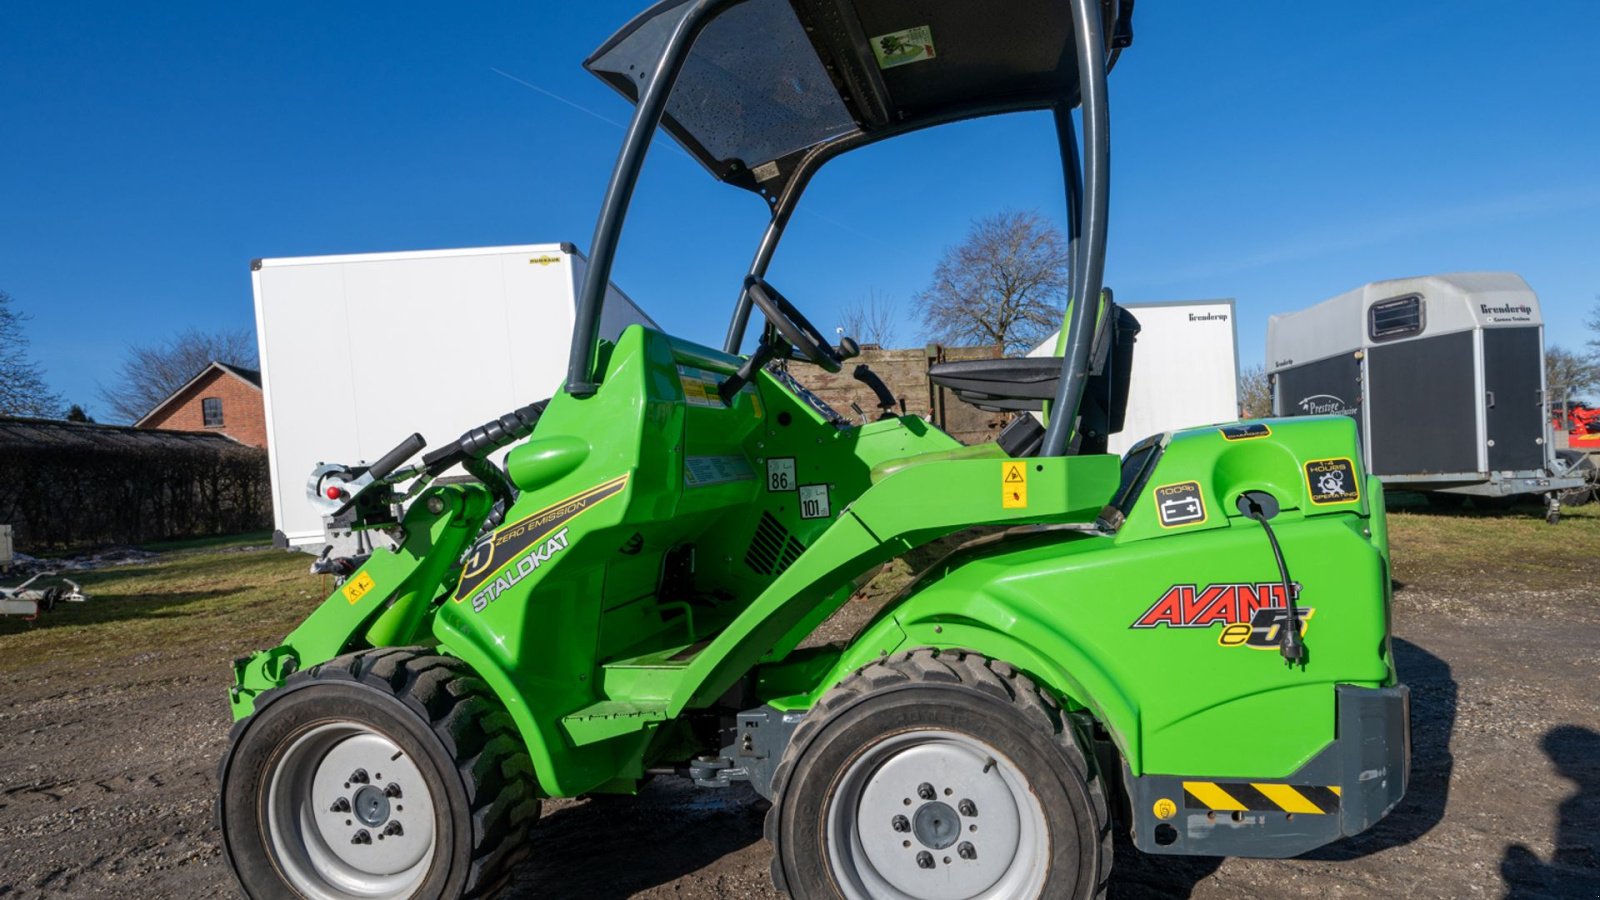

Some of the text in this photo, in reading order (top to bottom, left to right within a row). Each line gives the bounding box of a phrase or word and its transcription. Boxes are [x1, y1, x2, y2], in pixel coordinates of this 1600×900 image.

[1188, 311, 1228, 322] Brenderup
[1480, 303, 1532, 315] Brenderup
[1309, 400, 1339, 415] Prestige
[1310, 464, 1347, 472] HOURS
[771, 472, 788, 489] 86
[1160, 485, 1195, 496] 100%
[802, 499, 820, 516] 101
[496, 499, 587, 547] ZERO EMISSION
[471, 526, 571, 614] STALDKAT
